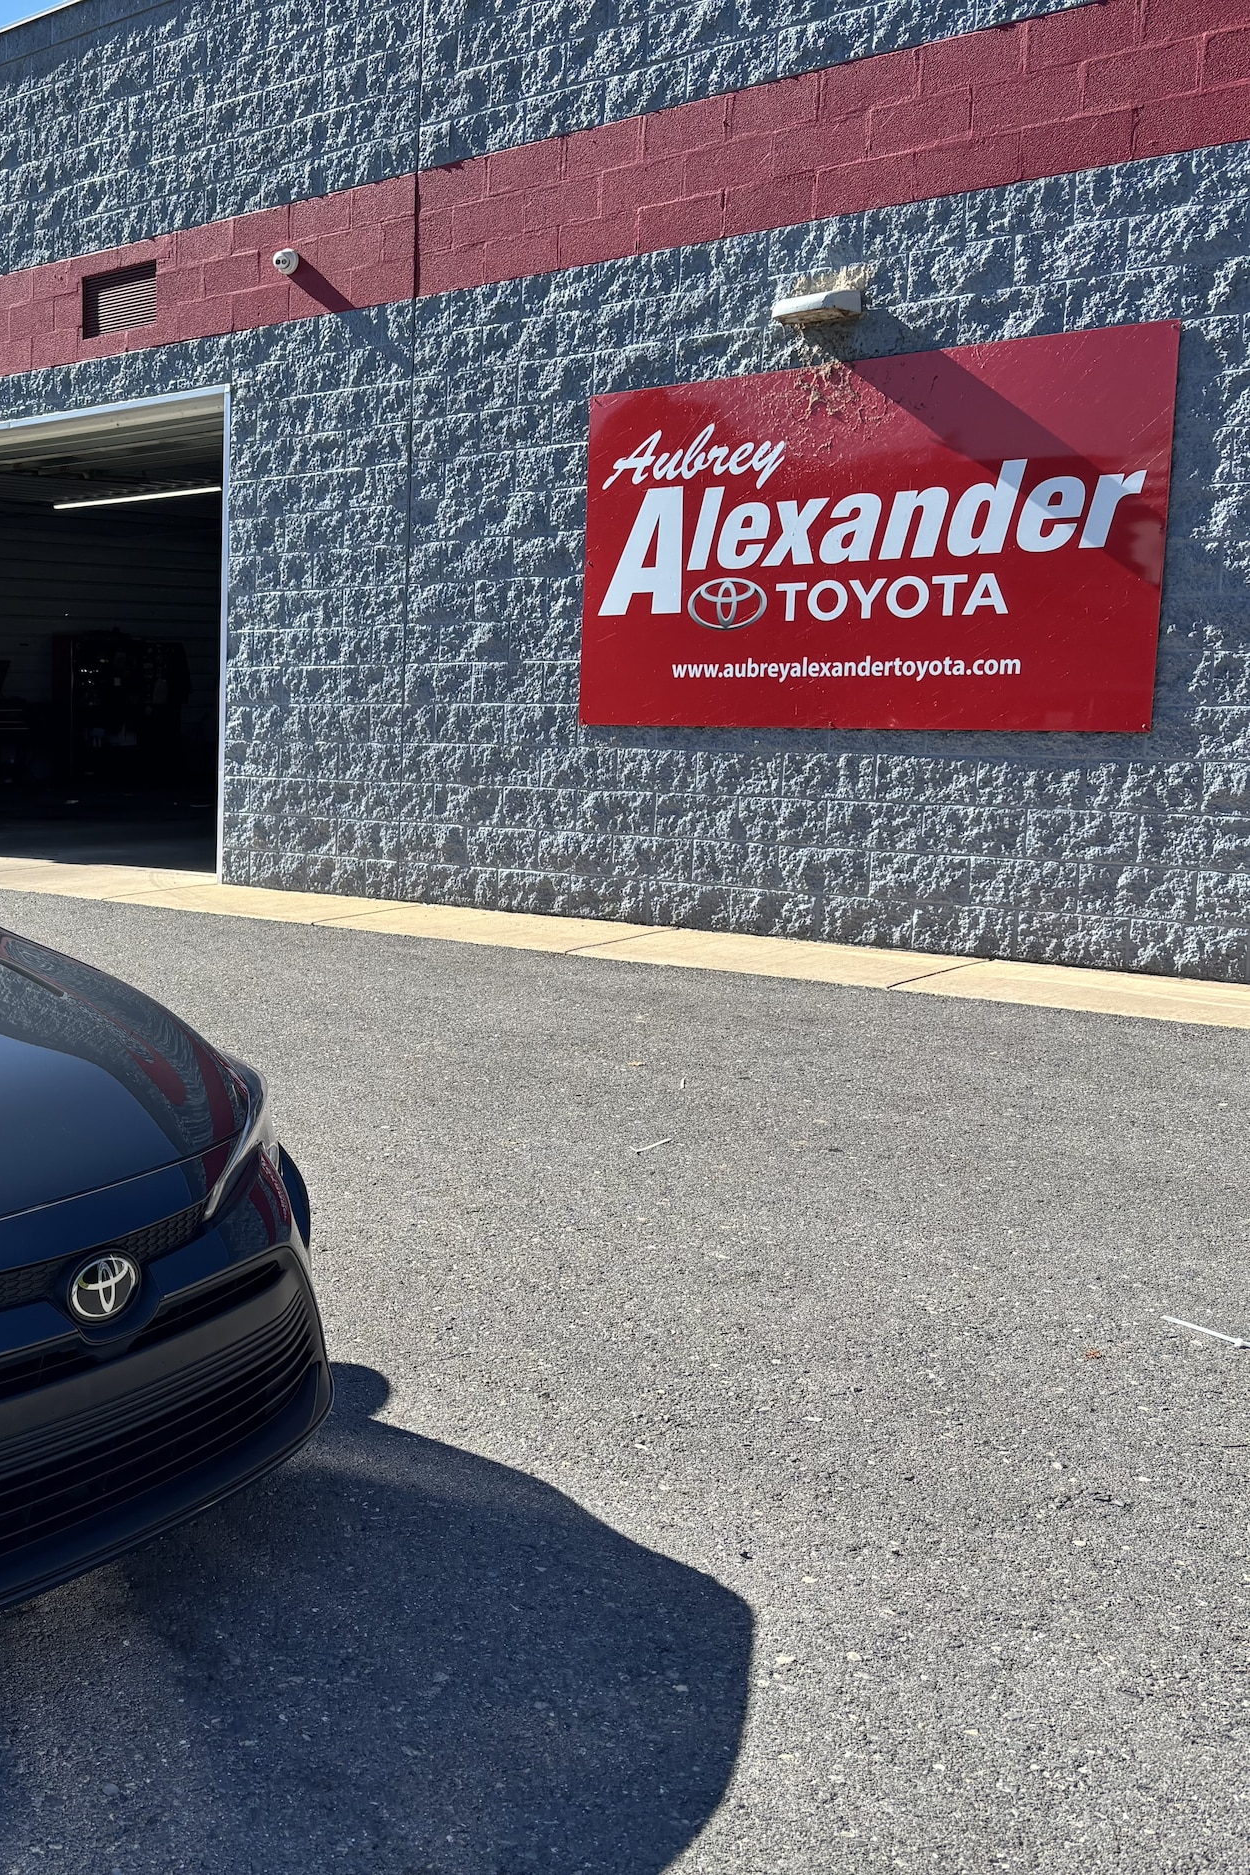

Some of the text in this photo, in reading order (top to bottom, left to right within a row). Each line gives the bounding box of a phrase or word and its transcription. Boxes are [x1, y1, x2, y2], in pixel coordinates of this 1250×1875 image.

[602, 423, 787, 490] Aubrey
[597, 459, 1147, 617] Alexander
[775, 573, 1009, 622] TOYOTA
[671, 656, 1021, 683] www.aubreyalexandertoyota.com
